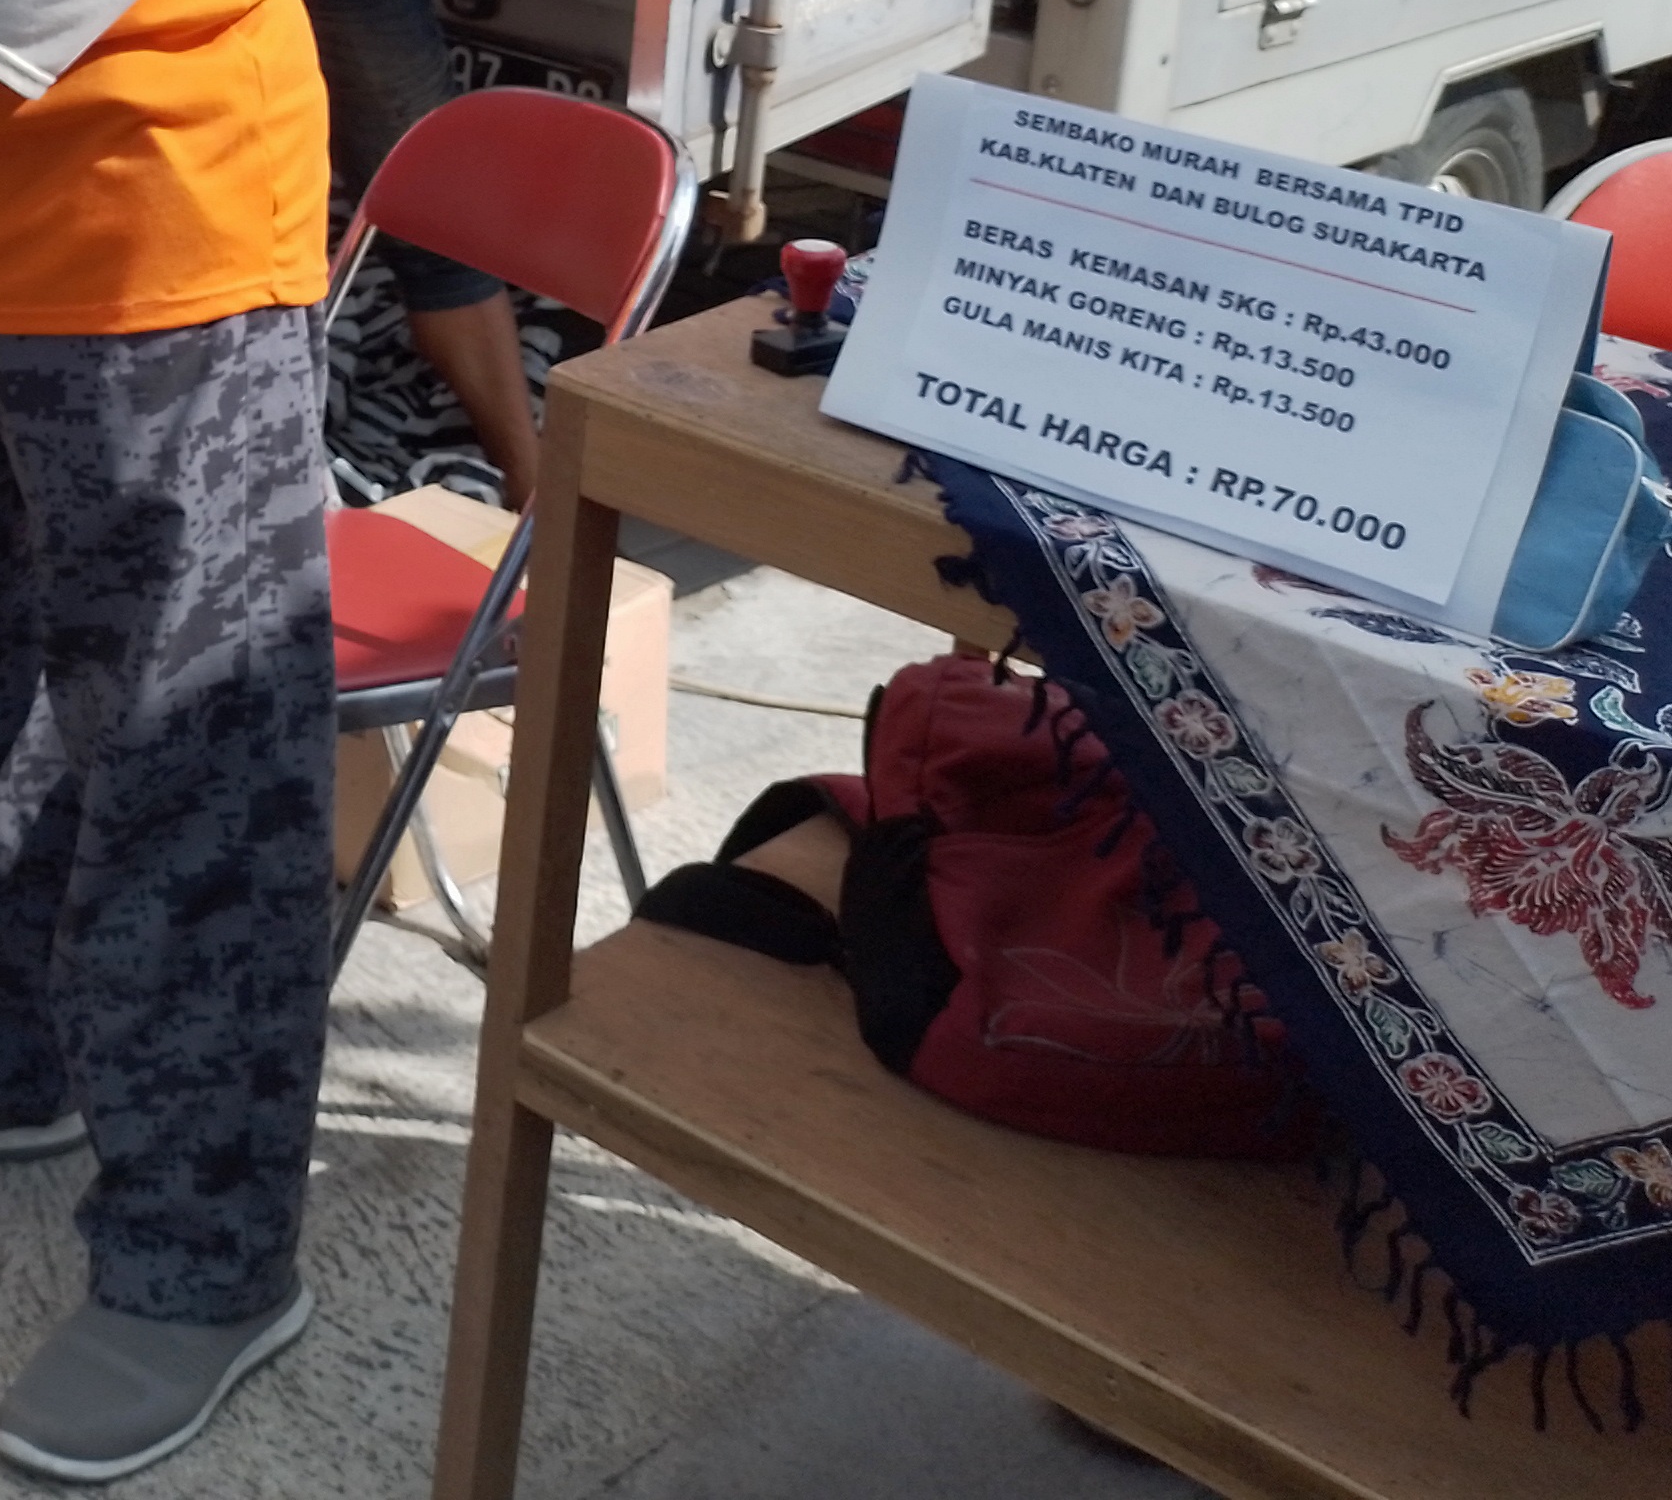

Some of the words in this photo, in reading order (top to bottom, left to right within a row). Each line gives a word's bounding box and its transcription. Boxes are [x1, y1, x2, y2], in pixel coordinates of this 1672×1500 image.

[979, 137, 1137, 193] KAB.KLATEN
[1150, 180, 1205, 210] DAN
[1213, 197, 1305, 235] BULOG
[1313, 220, 1486, 282] SURAKARTA
[1014, 109, 1135, 153] SEMBAKO
[1142, 141, 1240, 180] MURAH
[1256, 168, 1388, 217] BERSAMA
[1399, 202, 1465, 234] TPID
[942, 296, 1014, 332] GULA
[1022, 319, 1113, 361] MANIS
[1119, 347, 1185, 383] KITA
[1211, 375, 1356, 433] Rp.13.500
[954, 257, 1061, 304] MINYAK
[1068, 290, 1188, 339] GORENG
[1212, 331, 1356, 389] Rp.13.500
[964, 219, 1054, 260] BERAS
[1069, 248, 1211, 304] KEMASAN
[1216, 289, 1277, 321] 5KG
[1302, 312, 1451, 371] Rp.43.000
[915, 371, 1028, 432] TOTAL
[1038, 413, 1174, 479] HARGA
[1210, 466, 1408, 552] RP.70.000
